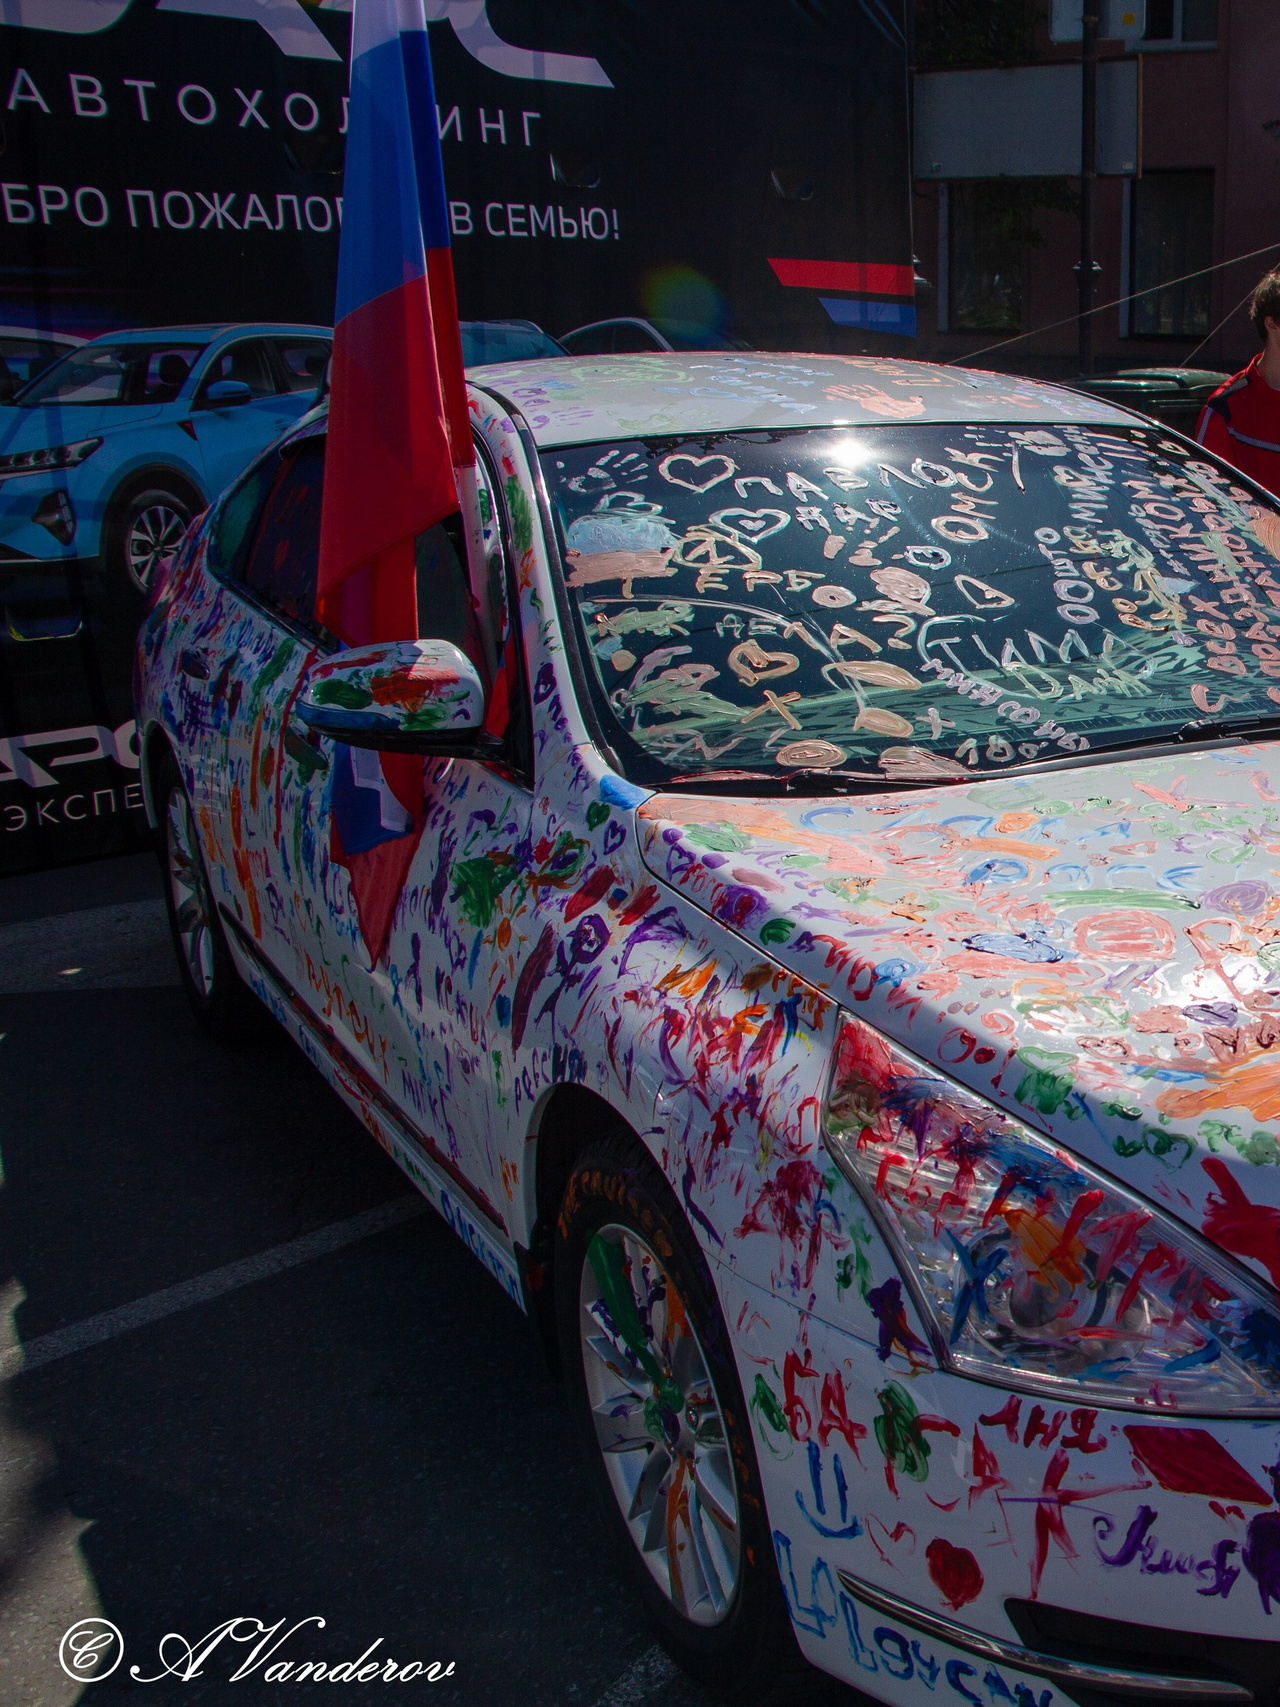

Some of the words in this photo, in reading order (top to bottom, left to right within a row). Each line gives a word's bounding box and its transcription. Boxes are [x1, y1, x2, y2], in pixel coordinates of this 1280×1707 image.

[6, 66, 541, 148] АВТОХОИНГ
[450, 202, 473, 235] В
[486, 203, 620, 241] СЕМЬЮ!
